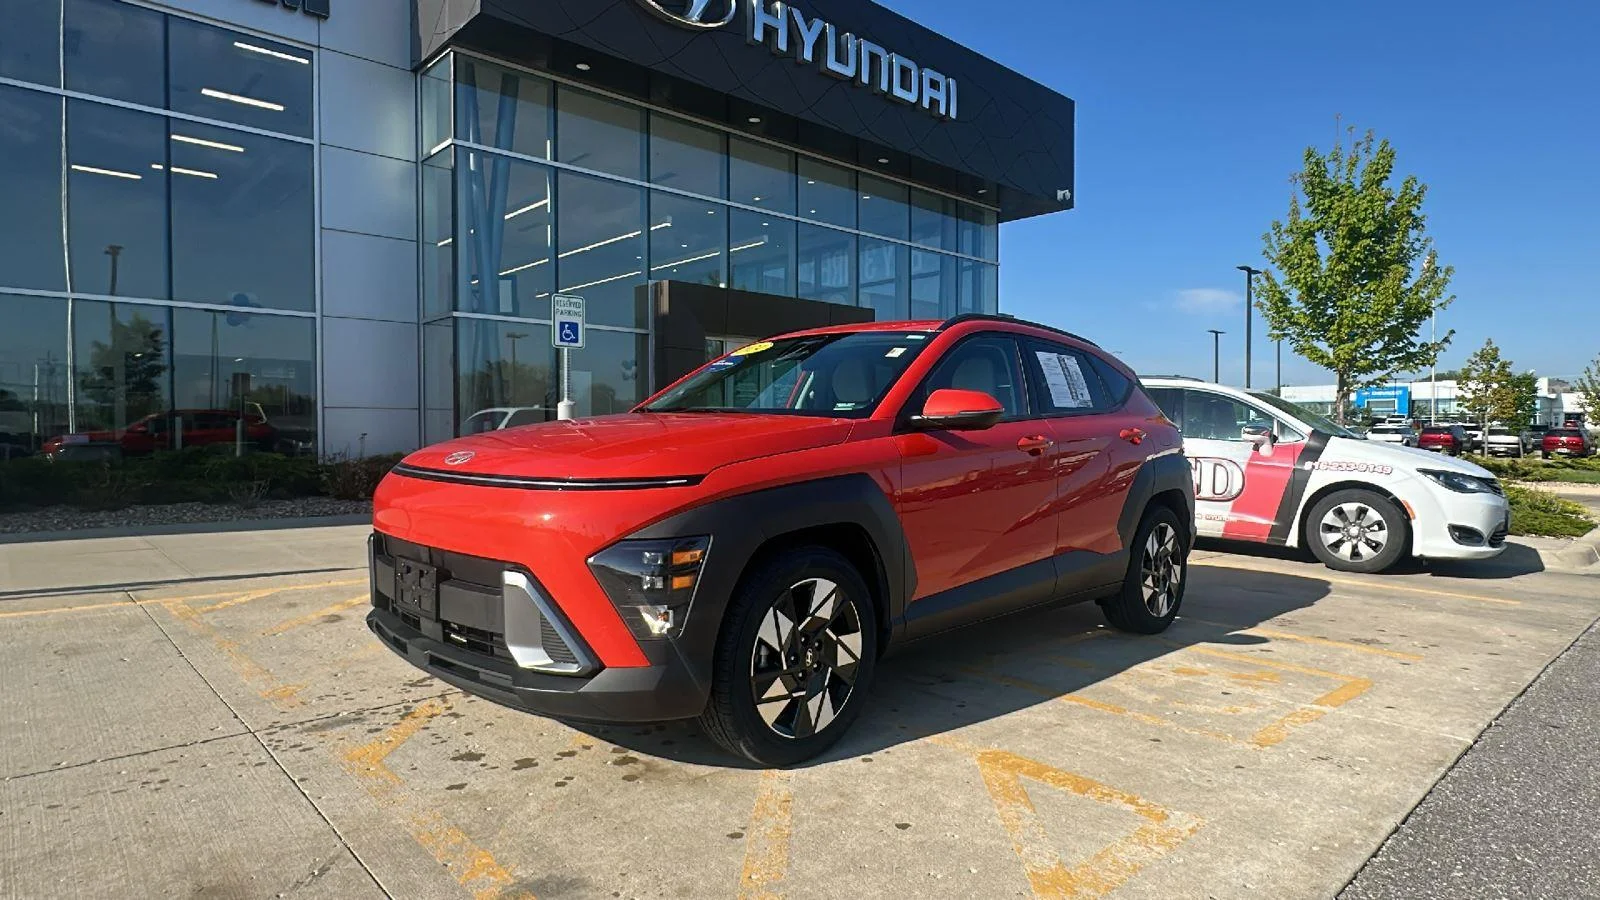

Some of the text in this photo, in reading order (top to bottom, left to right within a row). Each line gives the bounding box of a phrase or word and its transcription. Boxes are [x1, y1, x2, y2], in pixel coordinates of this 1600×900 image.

[748, 0, 958, 119] HYUNDAI
[555, 299, 582, 309] RESERVED
[555, 308, 582, 317] PARKING
